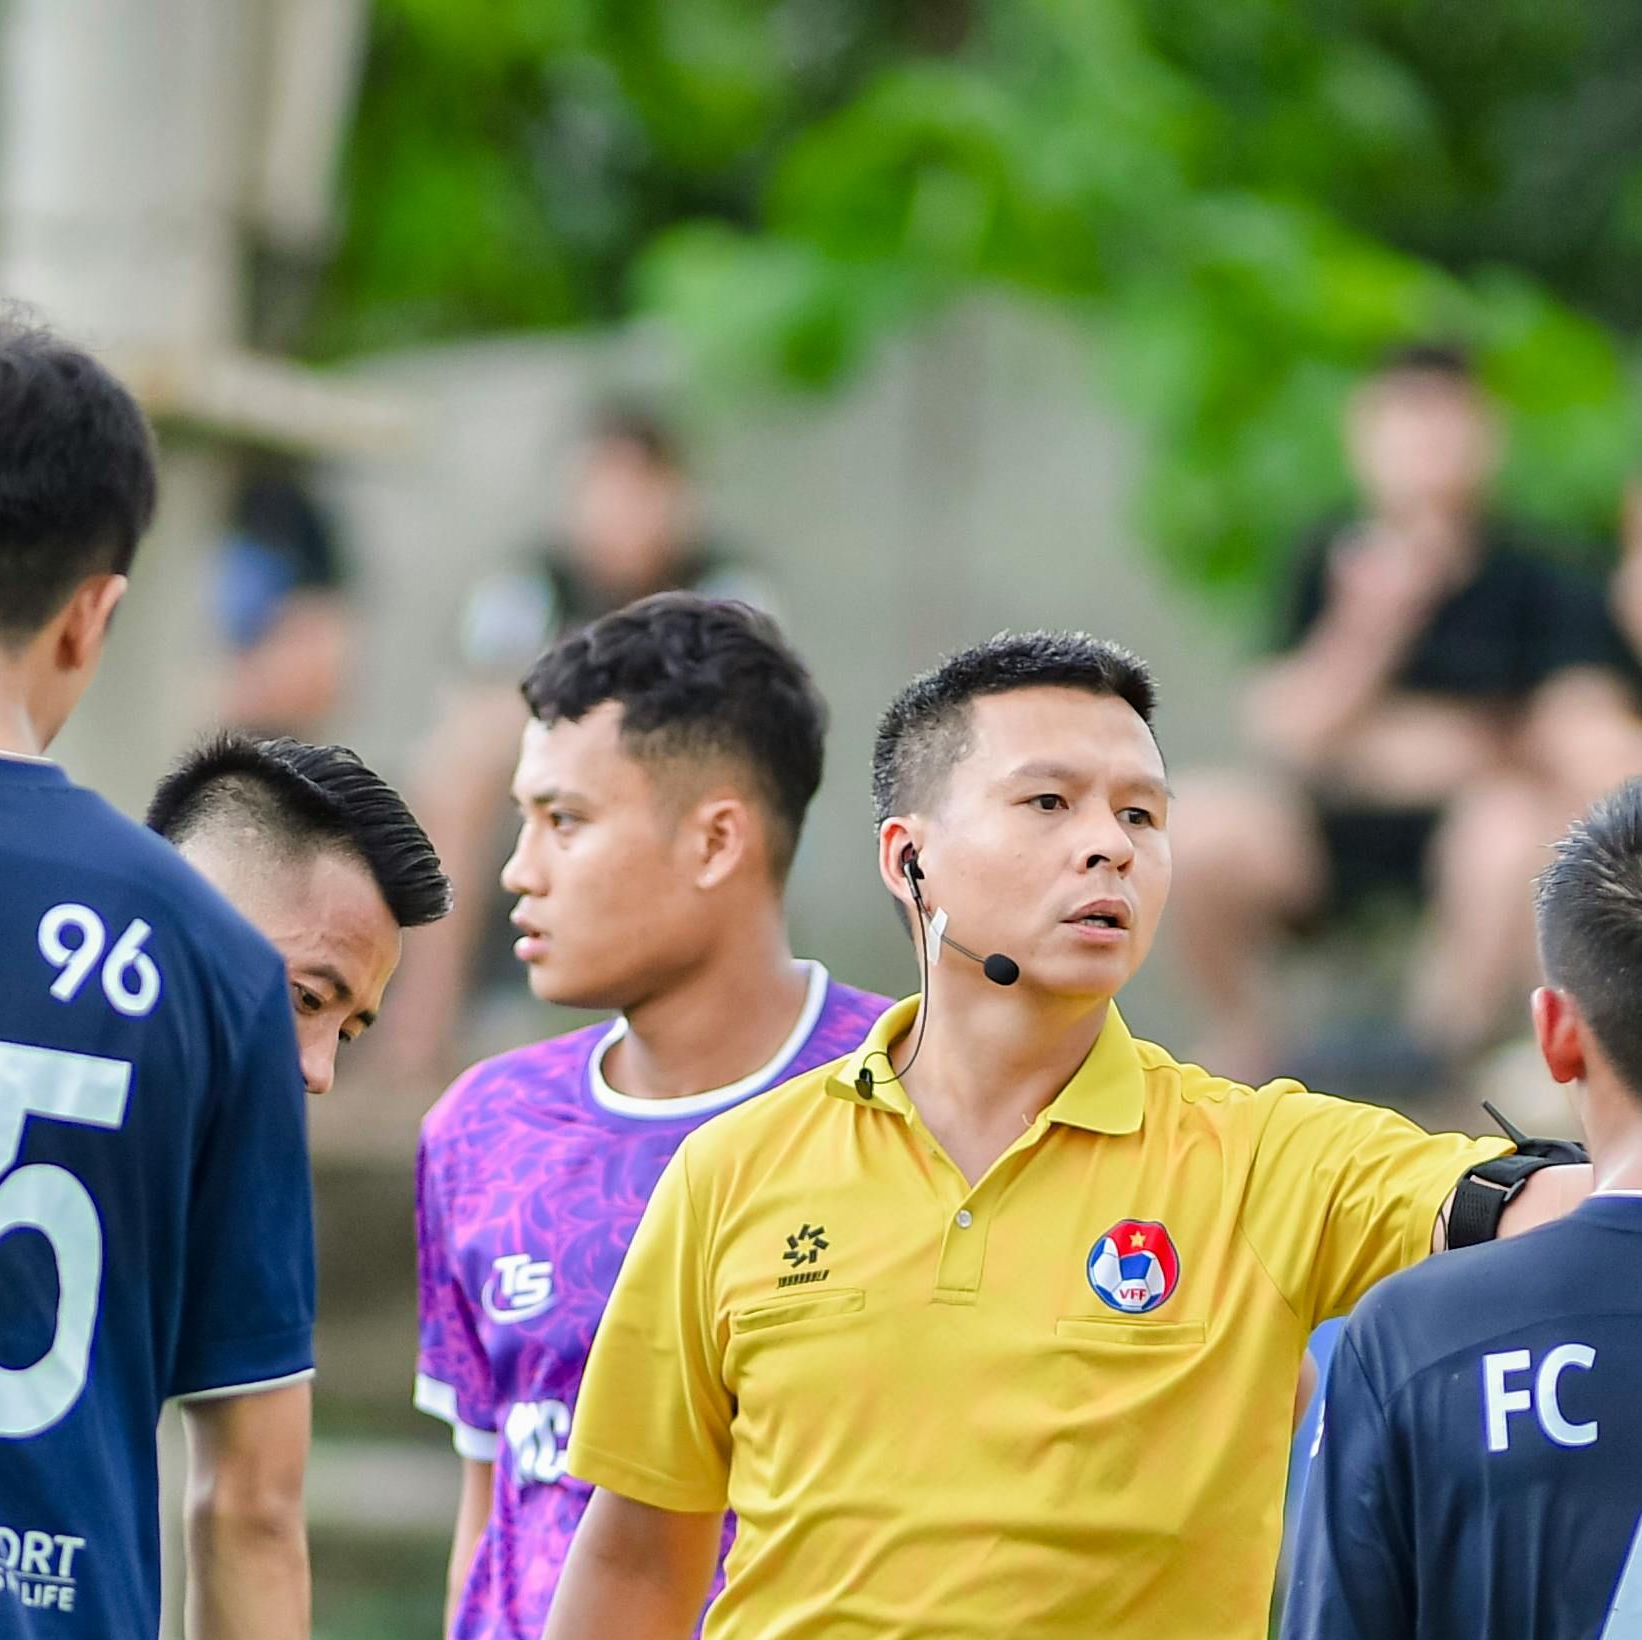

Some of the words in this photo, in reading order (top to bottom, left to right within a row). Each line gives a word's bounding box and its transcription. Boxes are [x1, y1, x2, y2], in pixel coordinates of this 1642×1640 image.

[37, 903, 160, 1015] 96
[493, 1254, 553, 1306] TS
[1119, 1288, 1147, 1301] VFF
[1482, 1342, 1598, 1452] FC
[21, 1582, 75, 1612] LIFE
